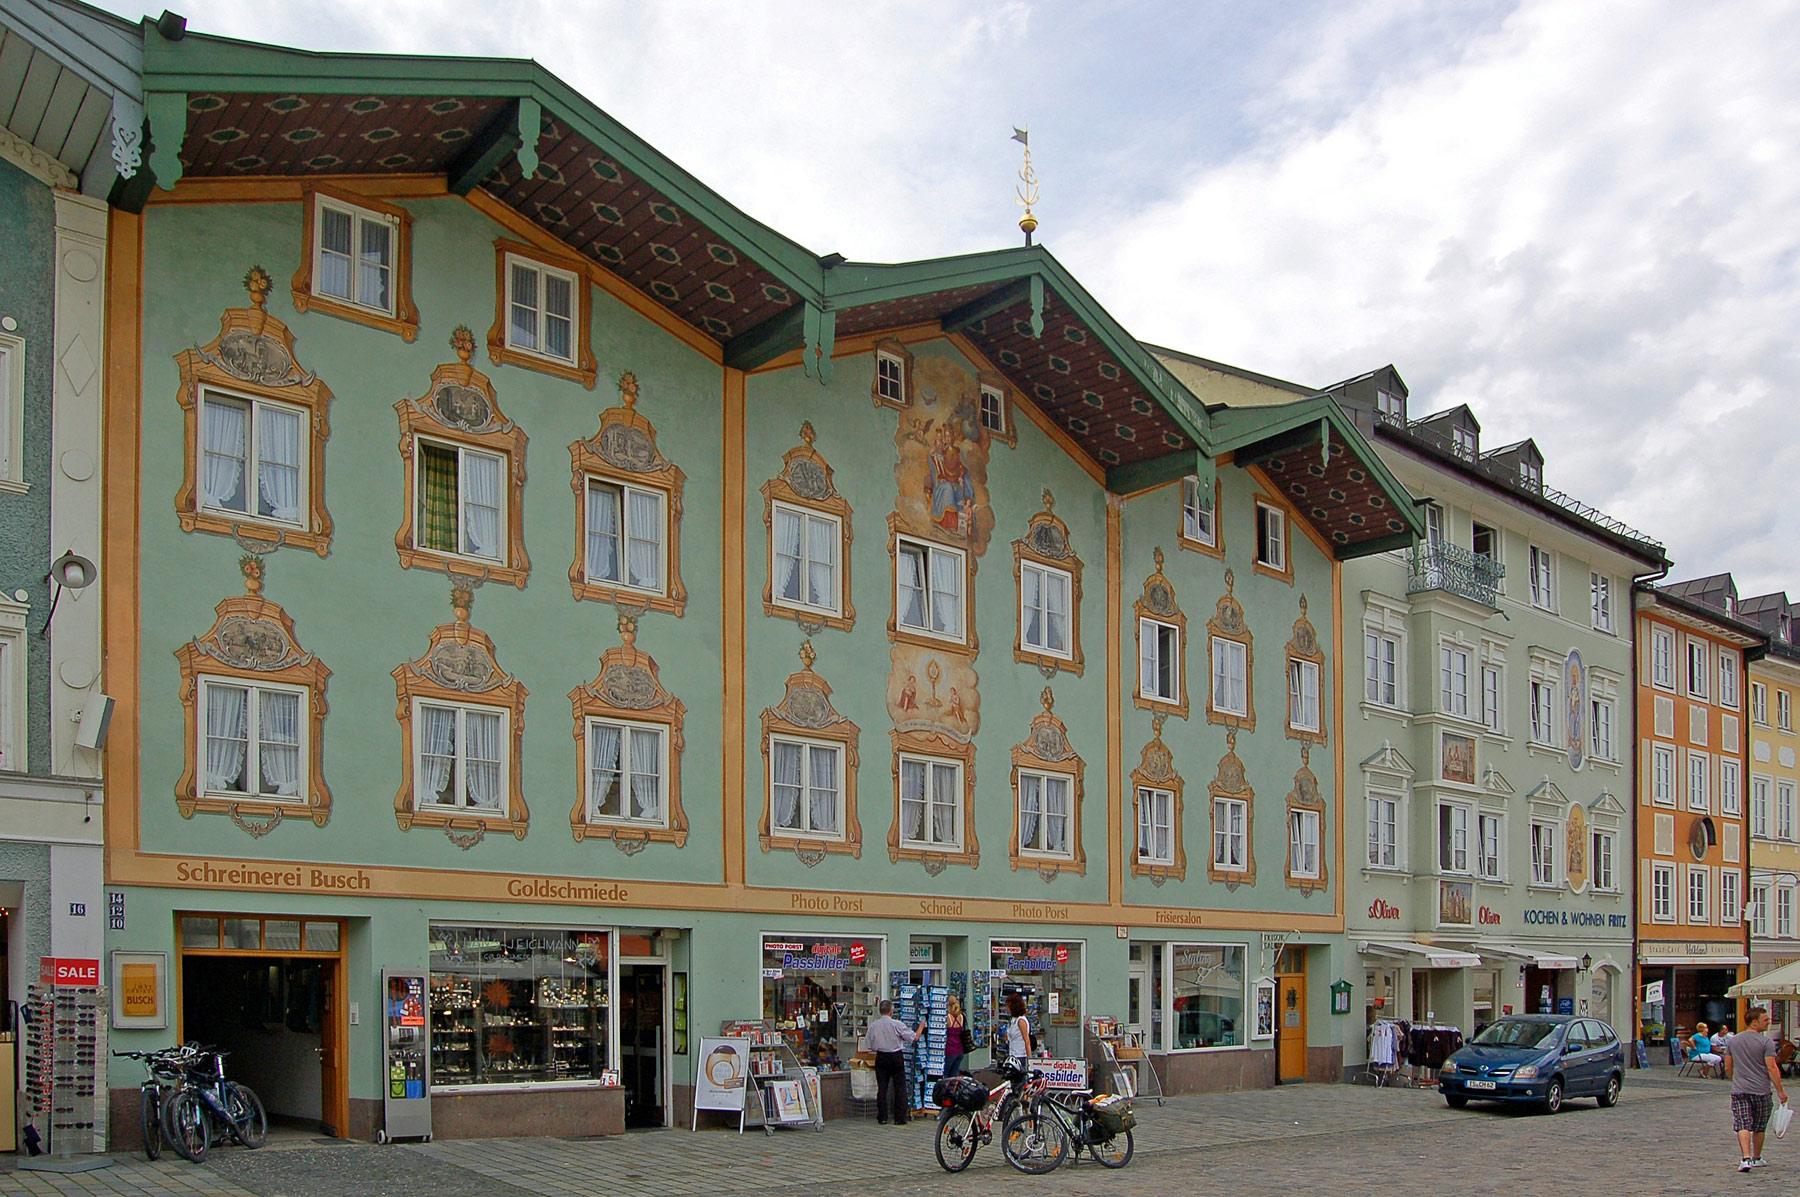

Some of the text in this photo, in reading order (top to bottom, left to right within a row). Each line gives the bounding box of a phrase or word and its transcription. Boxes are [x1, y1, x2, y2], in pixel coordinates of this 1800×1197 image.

[176, 862, 370, 889] Schreinerei Busch
[507, 879, 628, 901] Goldschmiede
[111, 893, 123, 904] 14
[791, 893, 863, 911] Photo Porst
[71, 904, 84, 915] 16
[111, 906, 123, 916] 12
[920, 900, 962, 915] Schneid
[1012, 904, 1068, 919] Photo Porst
[111, 919, 123, 929] 10
[1155, 911, 1202, 925] Frisiersalon
[1524, 909, 1627, 928] KOCHEN & WOHNEN FRITZ
[812, 943, 842, 956] digitale
[783, 954, 848, 970] Passbilder
[1007, 957, 1056, 970] Farbbilder
[41, 965, 54, 977] SALE
[58, 967, 96, 978] SALE
[127, 996, 153, 1004] BUSCH
[1053, 1061, 1076, 1071] digitale
